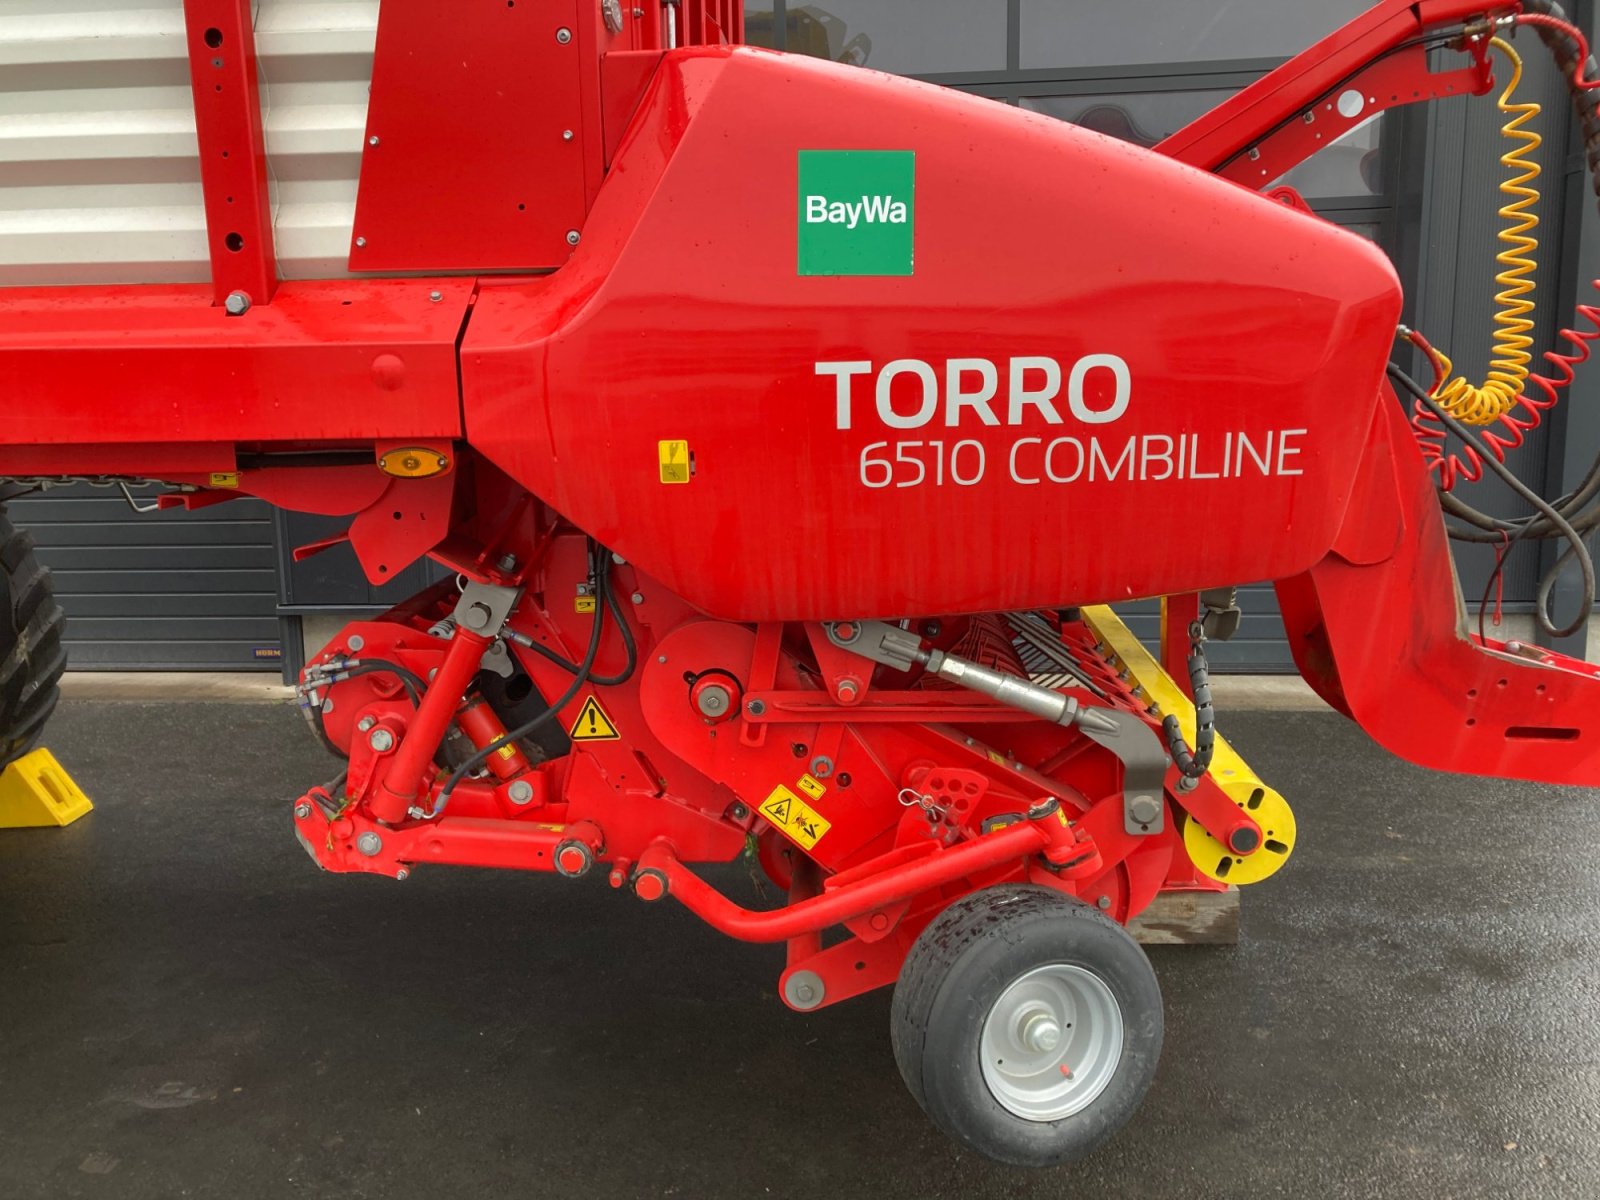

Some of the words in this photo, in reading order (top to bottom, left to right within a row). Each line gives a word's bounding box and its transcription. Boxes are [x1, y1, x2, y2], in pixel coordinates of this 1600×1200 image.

[805, 195, 907, 229] BayWa
[815, 353, 1132, 430] TORRO
[860, 439, 985, 489] 6510
[1009, 428, 1307, 485] COMBILINE
